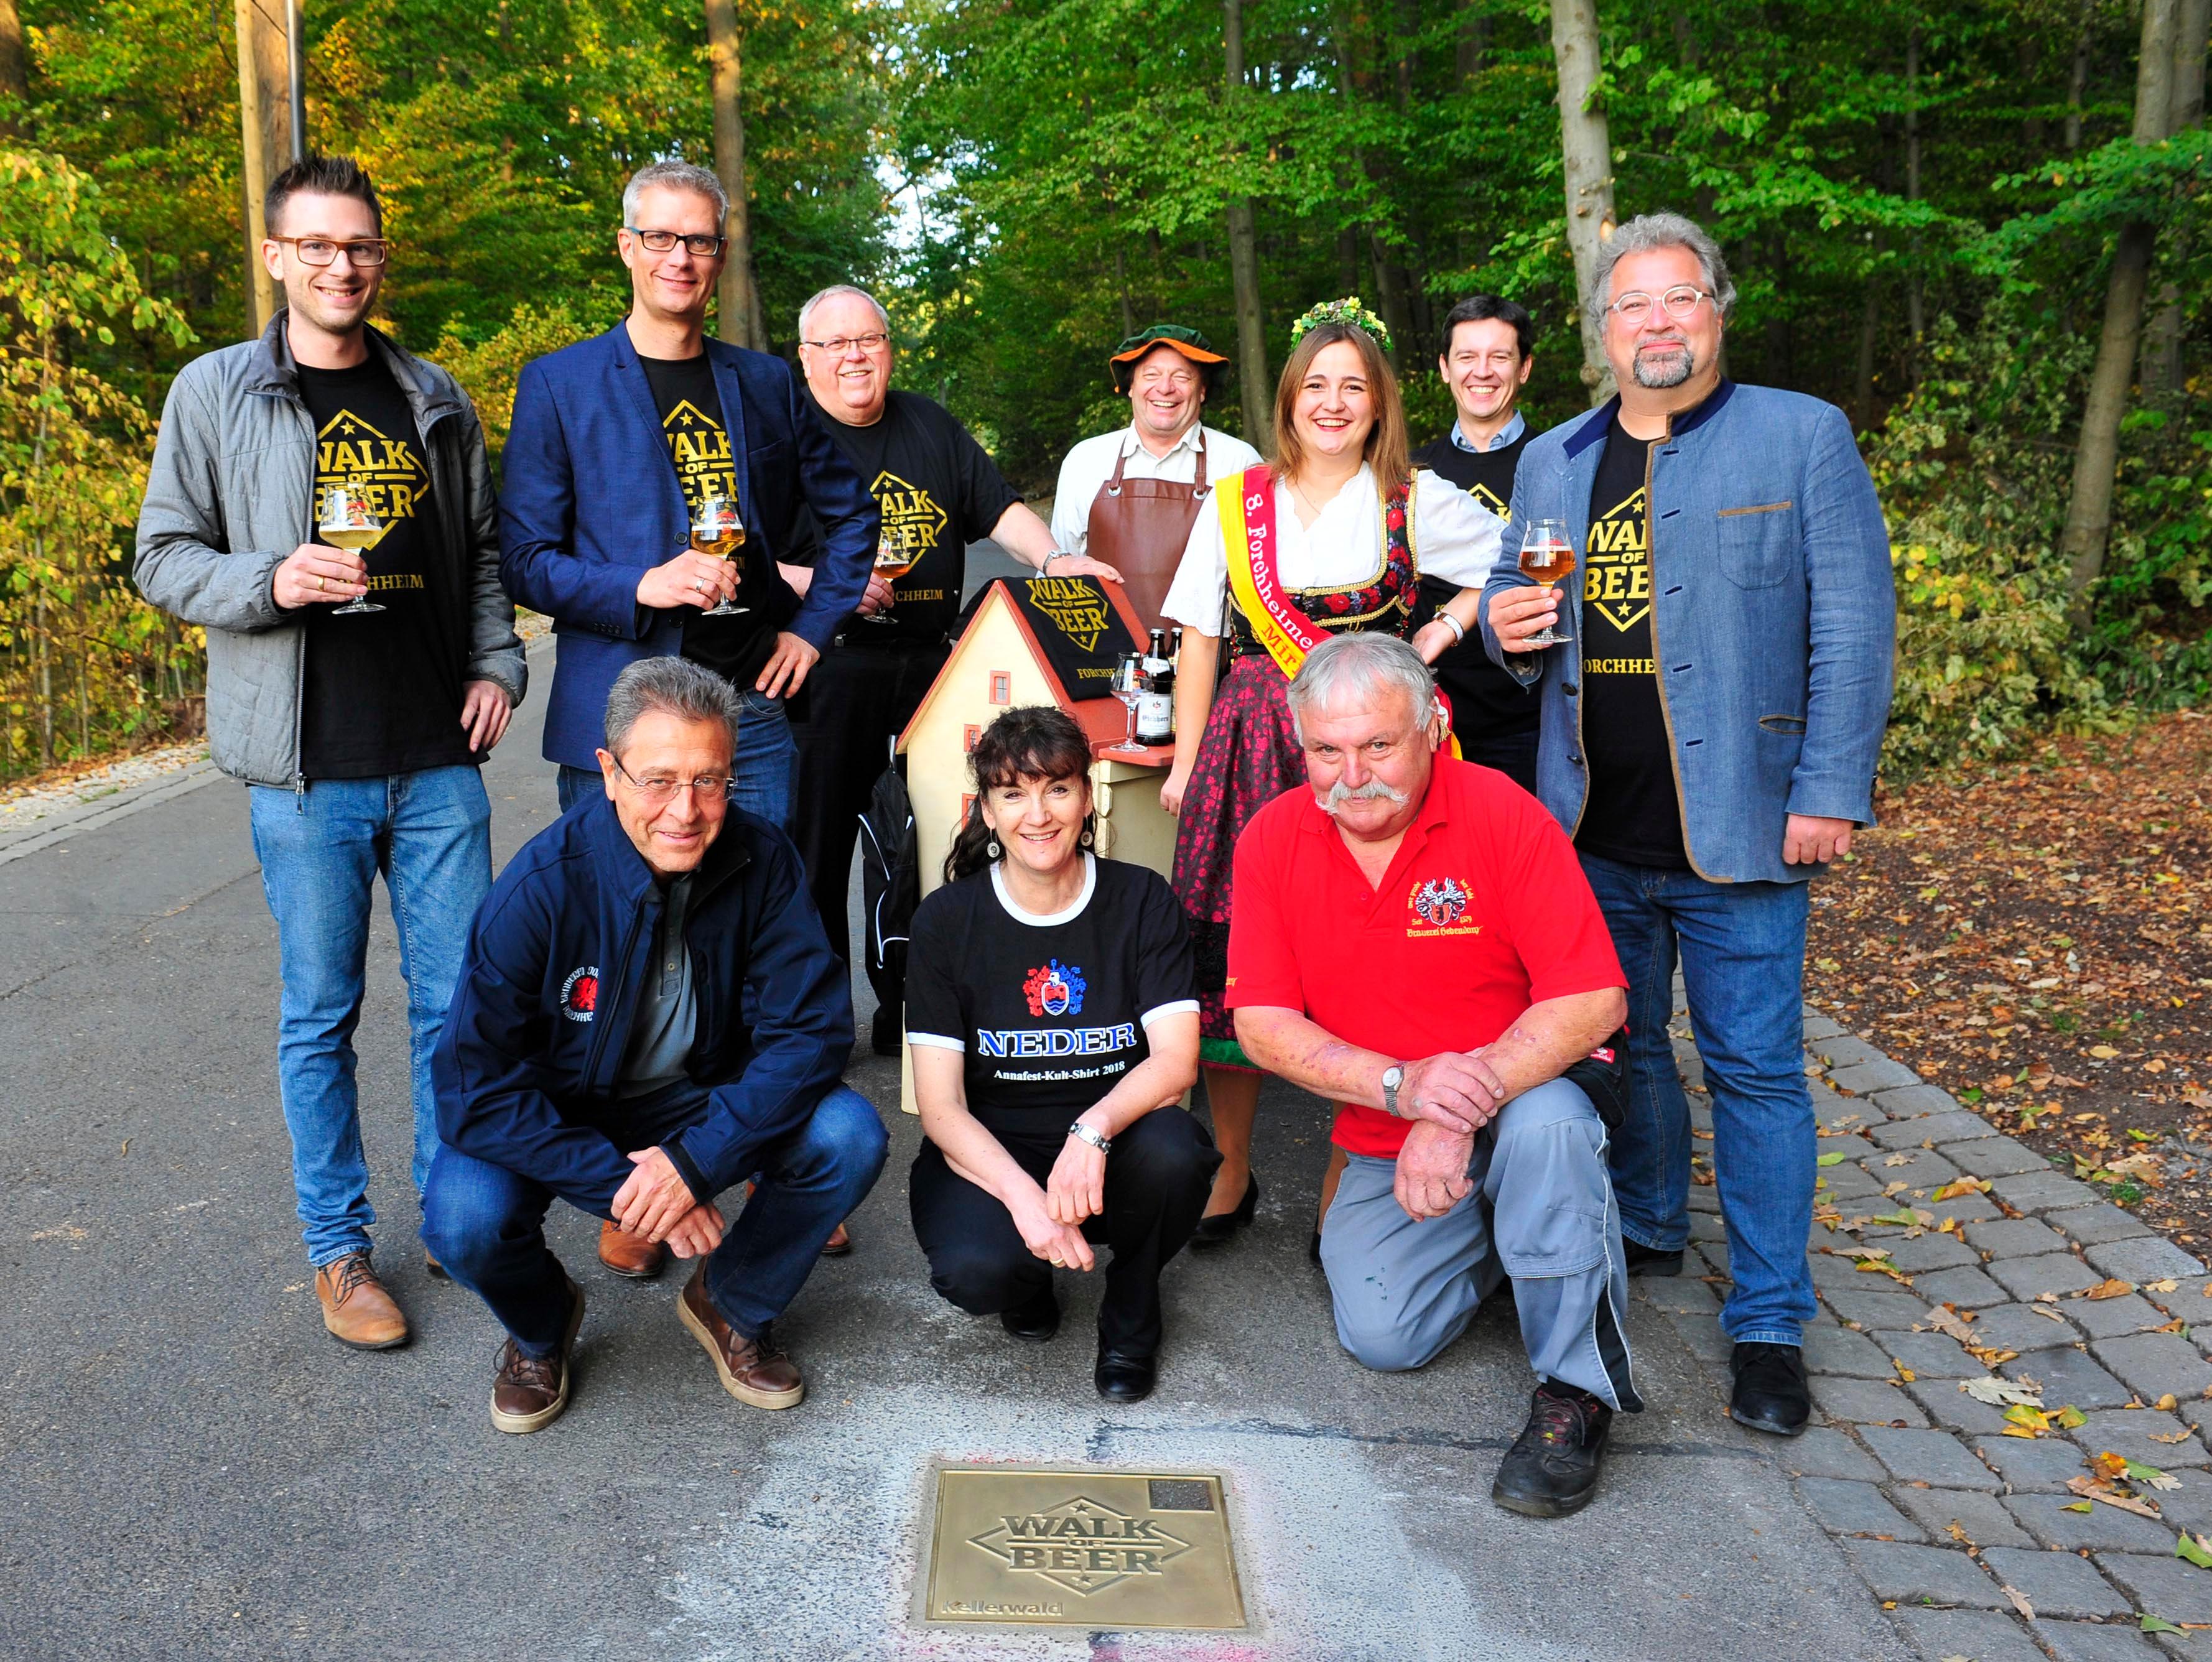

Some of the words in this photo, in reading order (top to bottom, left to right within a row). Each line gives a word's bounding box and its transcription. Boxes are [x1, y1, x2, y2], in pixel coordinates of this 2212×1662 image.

[348, 472, 373, 483] OF
[685, 462, 709, 474] OF
[873, 490, 933, 516] ALK
[1246, 493, 1263, 517] 8.
[890, 516, 908, 524] OF
[1620, 551, 1645, 564] OF
[1025, 578, 1095, 600] WALK
[1248, 524, 1313, 649] Forchheime
[1062, 600, 1074, 608] OF
[1047, 607, 1110, 633] BEER
[977, 1023, 1137, 1057] NEDER
[994, 1069, 1100, 1080] Annafest-Kult-Shirt
[1102, 1061, 1125, 1075] 2018
[1000, 1515, 1162, 1541] WALK
[1066, 1538, 1104, 1548] OF
[1008, 1546, 1162, 1575] BEER
[941, 1600, 1064, 1617] Kellerwald
